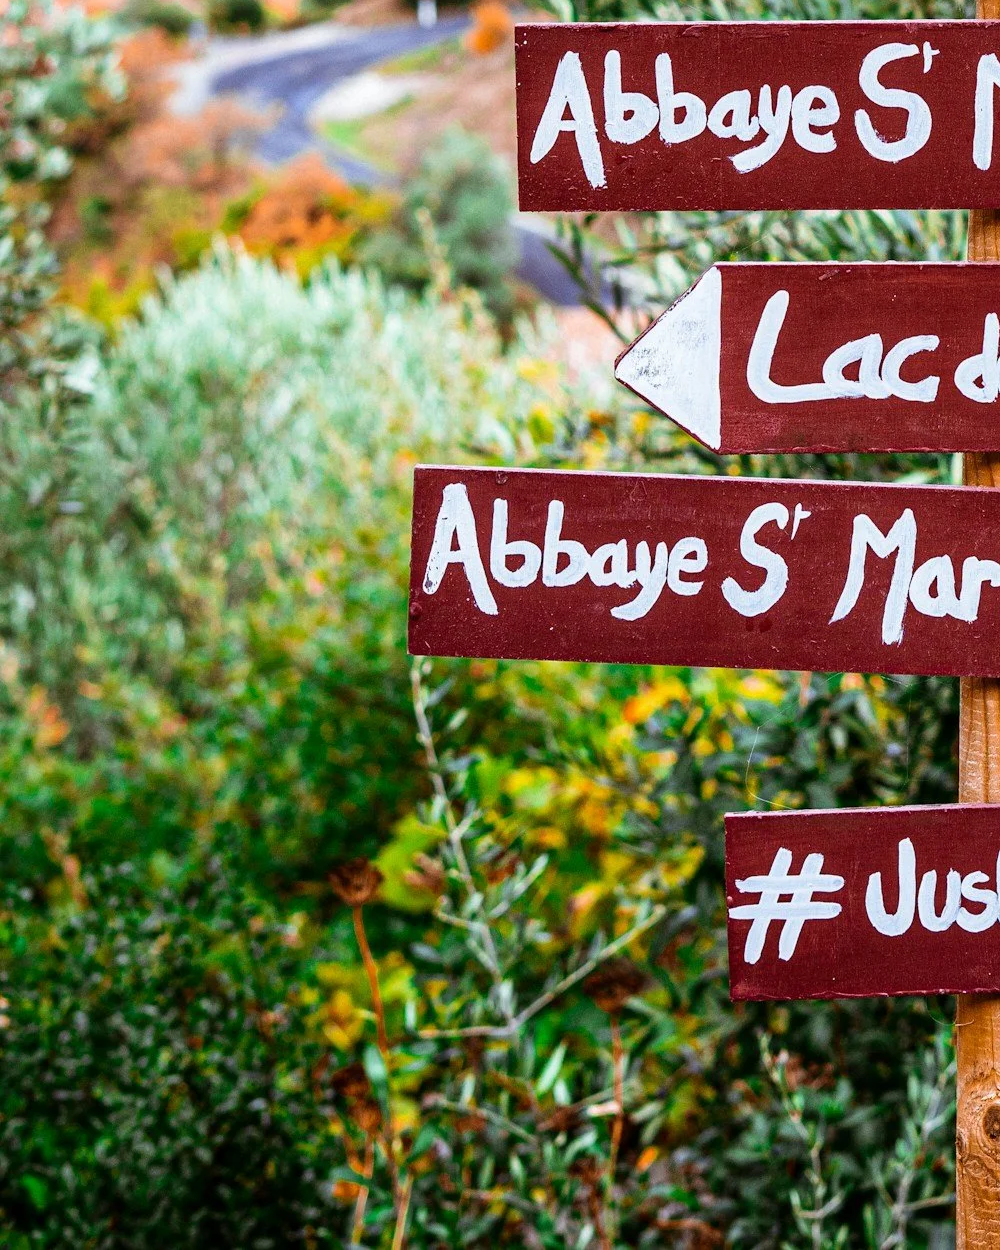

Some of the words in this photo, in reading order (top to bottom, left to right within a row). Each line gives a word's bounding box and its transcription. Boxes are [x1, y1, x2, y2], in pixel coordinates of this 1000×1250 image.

[529, 49, 841, 191] Abbaye
[746, 289, 941, 404] Lac
[422, 482, 709, 622] Abbaye
